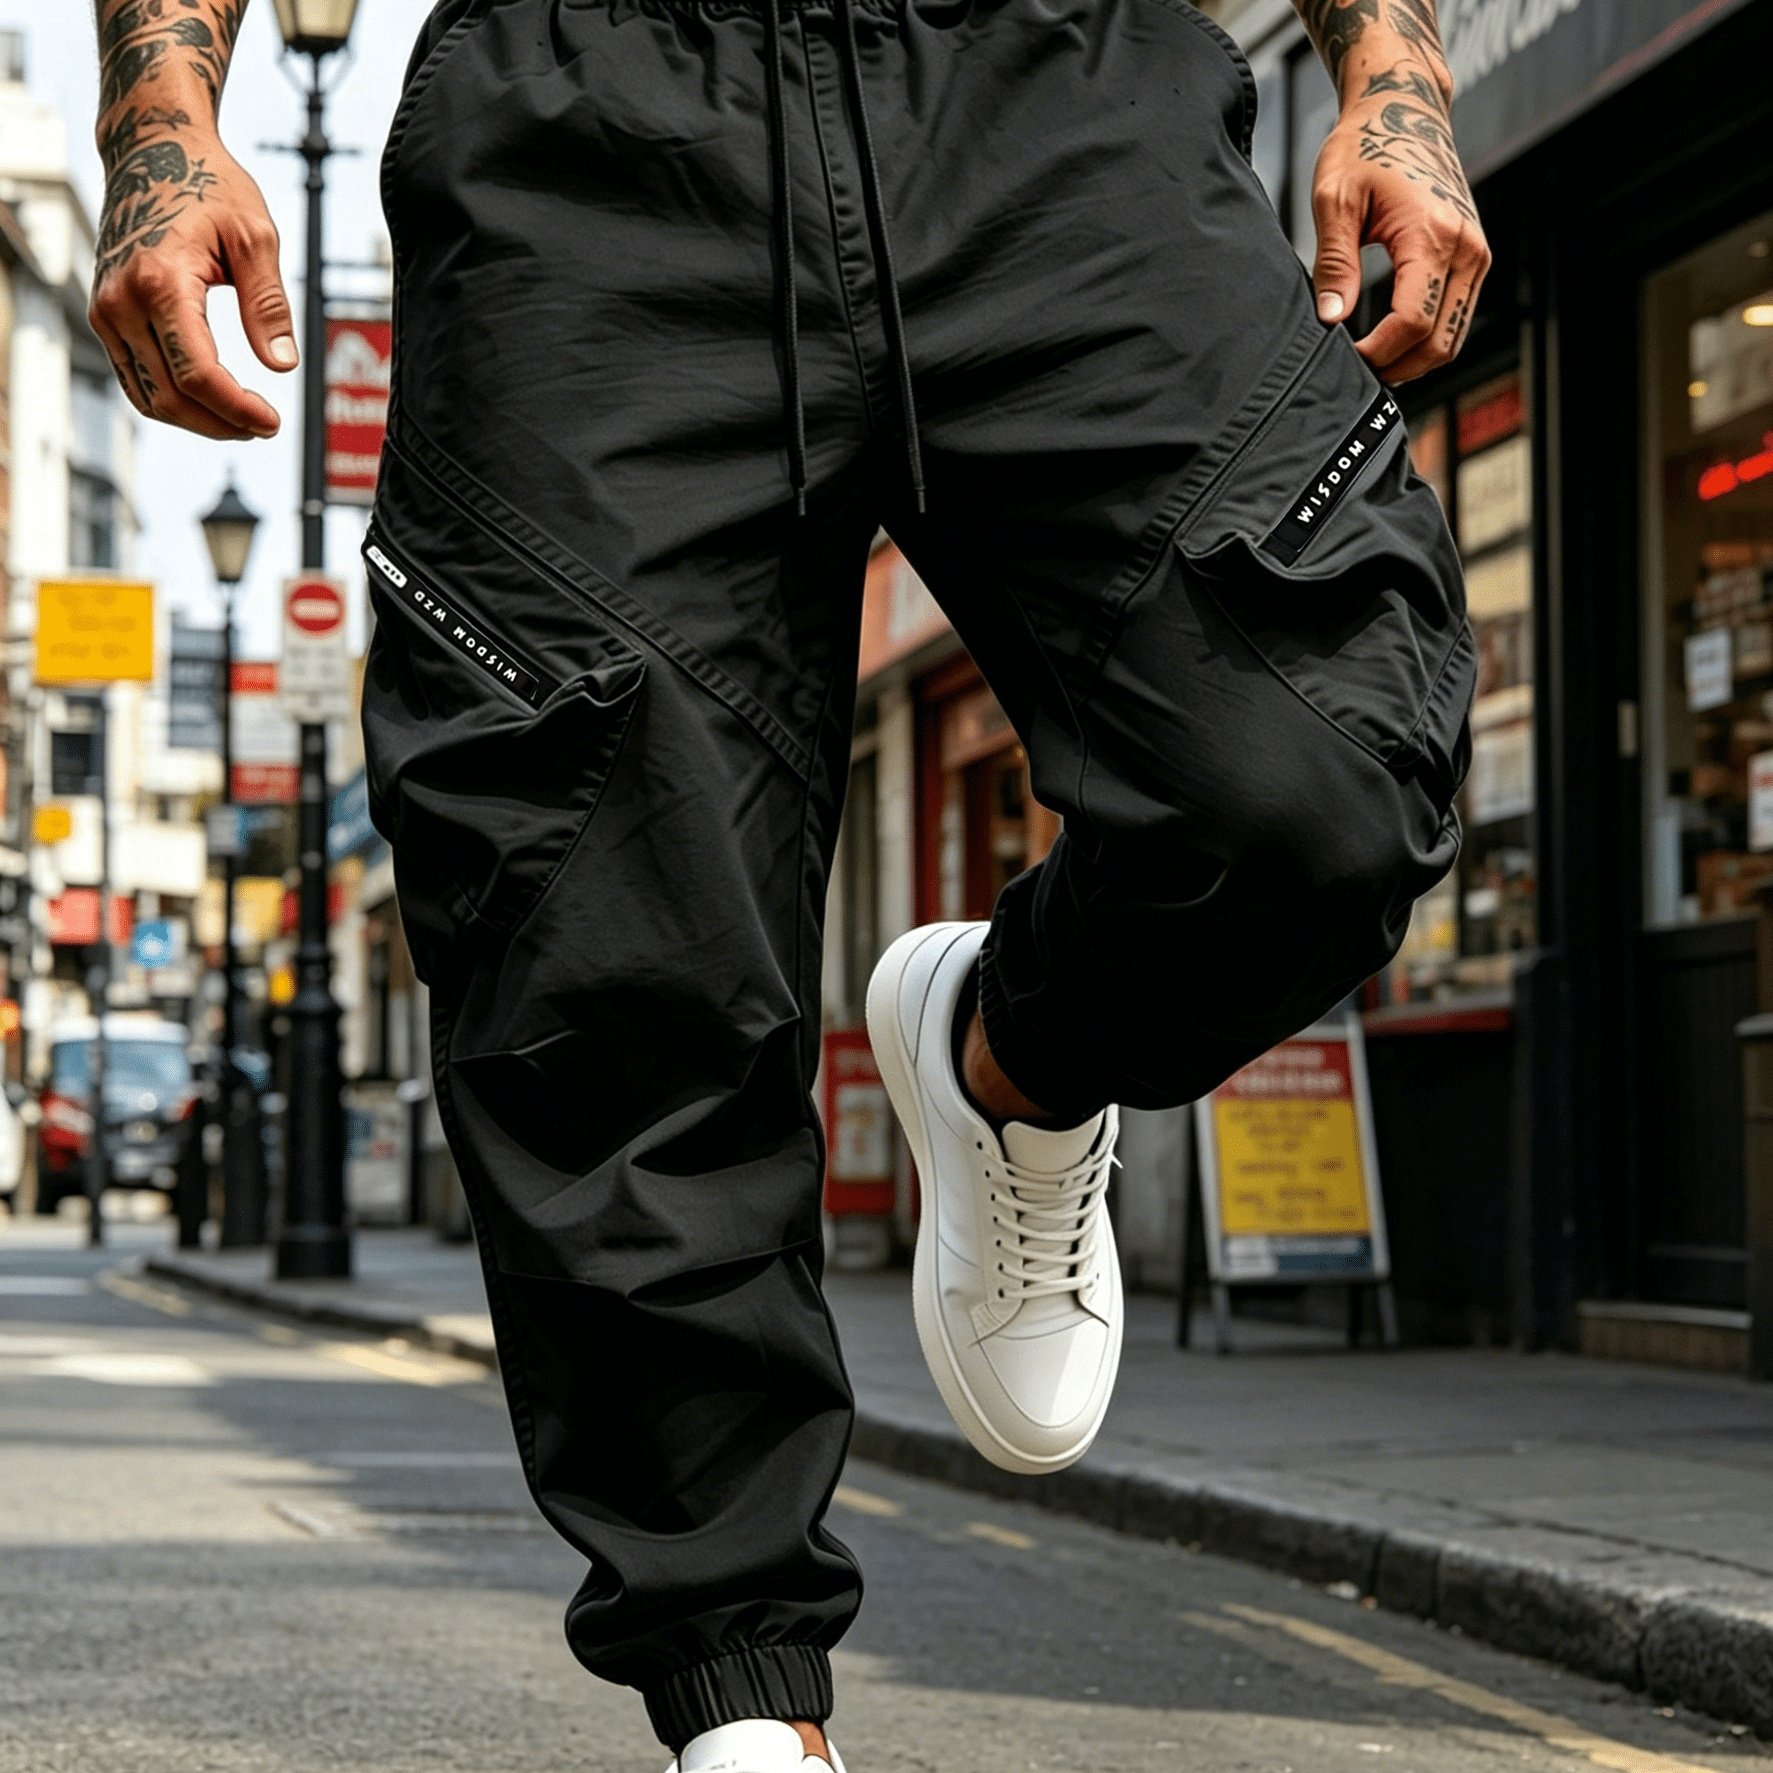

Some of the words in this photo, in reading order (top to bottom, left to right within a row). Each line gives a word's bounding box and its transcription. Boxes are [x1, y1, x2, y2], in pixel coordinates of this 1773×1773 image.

[1298, 440, 1365, 523] WISDOM
[414, 591, 447, 622] WZD
[453, 626, 517, 682] WISDOM
